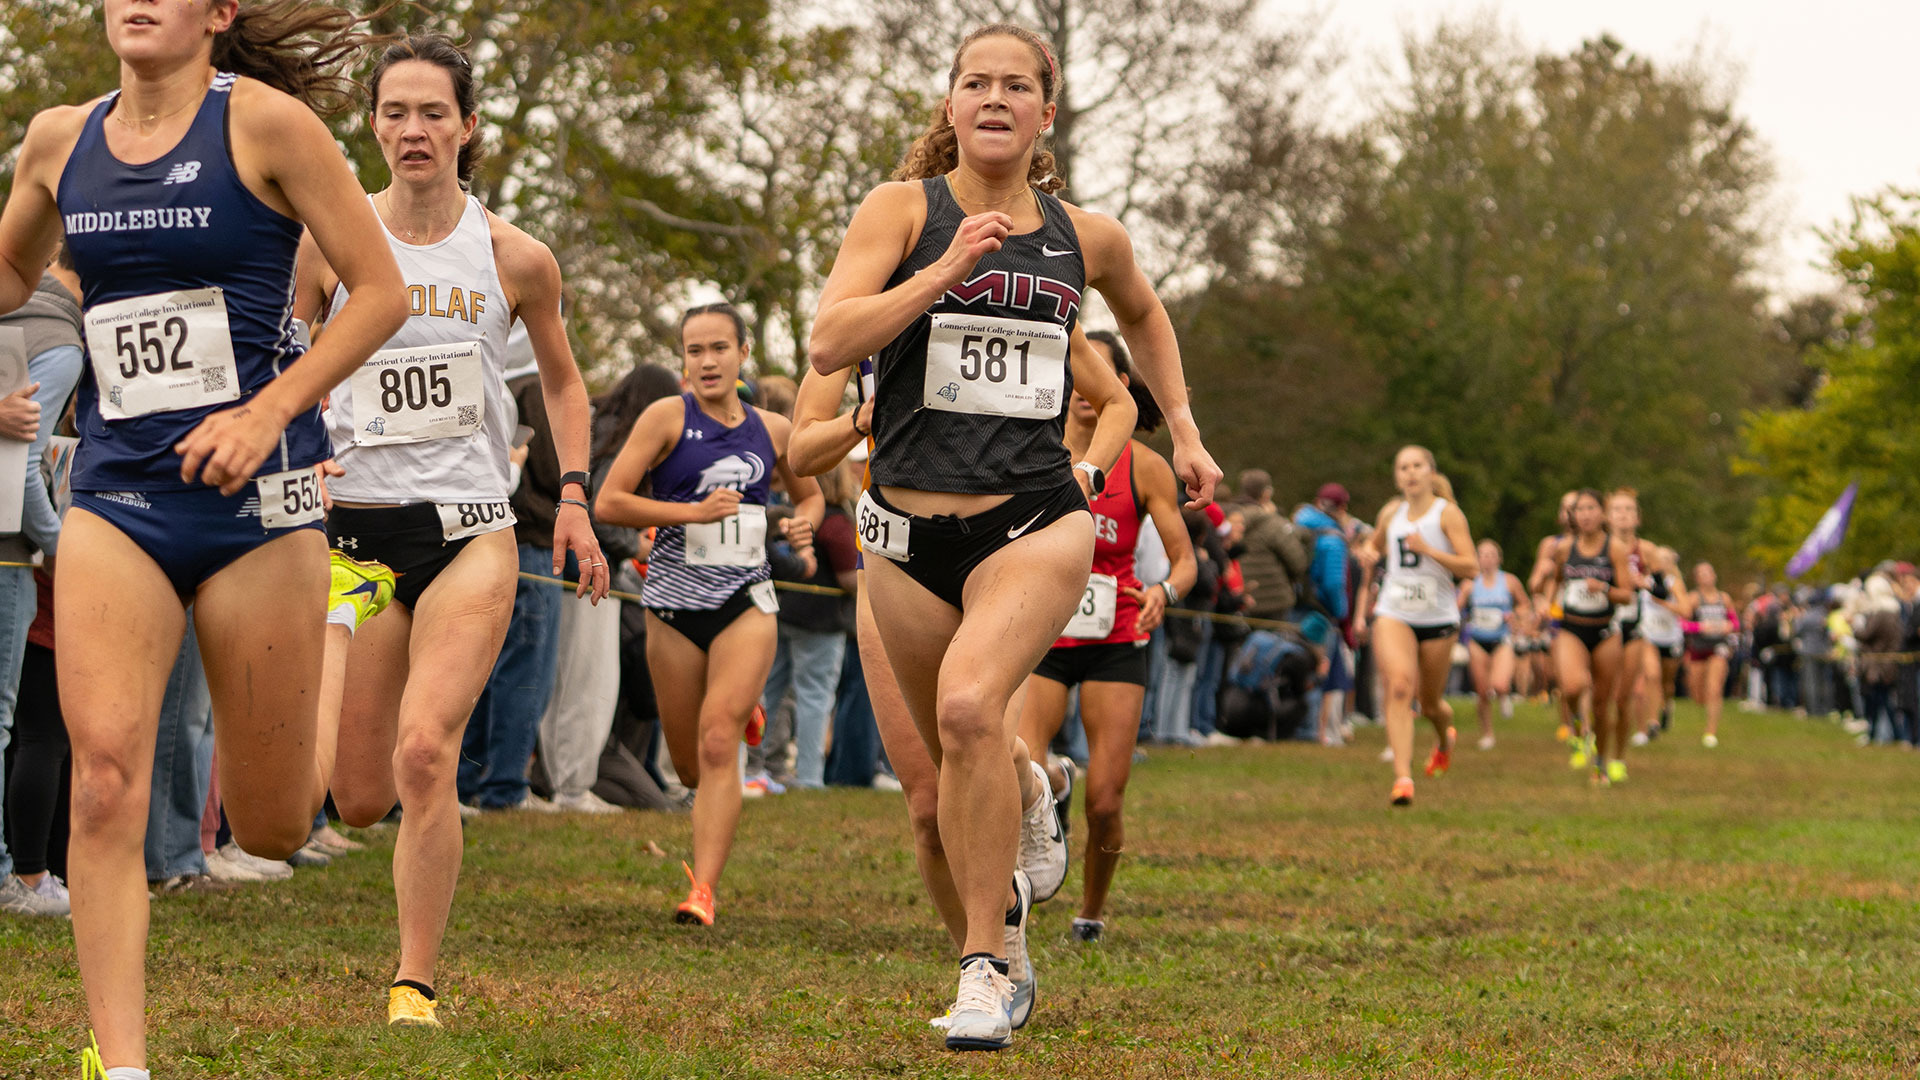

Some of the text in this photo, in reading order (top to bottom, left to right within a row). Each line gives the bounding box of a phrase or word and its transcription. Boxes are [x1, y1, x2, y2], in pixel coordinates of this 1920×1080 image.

[65, 206, 212, 235] MIDDLEBURY
[407, 284, 486, 325] OLAF
[914, 269, 1082, 322] MIT
[91, 298, 216, 327] Connecticut College Invitational
[939, 321, 986, 333] Connecticut
[986, 325, 1016, 337] College
[115, 316, 194, 379] 552
[362, 349, 473, 367] nnecticut College Invitational
[960, 334, 1031, 385] 581
[379, 363, 452, 414] 805
[95, 491, 152, 510] MIDDLEBURY
[283, 474, 322, 516] 552
[457, 503, 506, 528] 805
[720, 516, 741, 544] 11
[859, 504, 890, 550] 581
[1397, 538, 1422, 568] B
